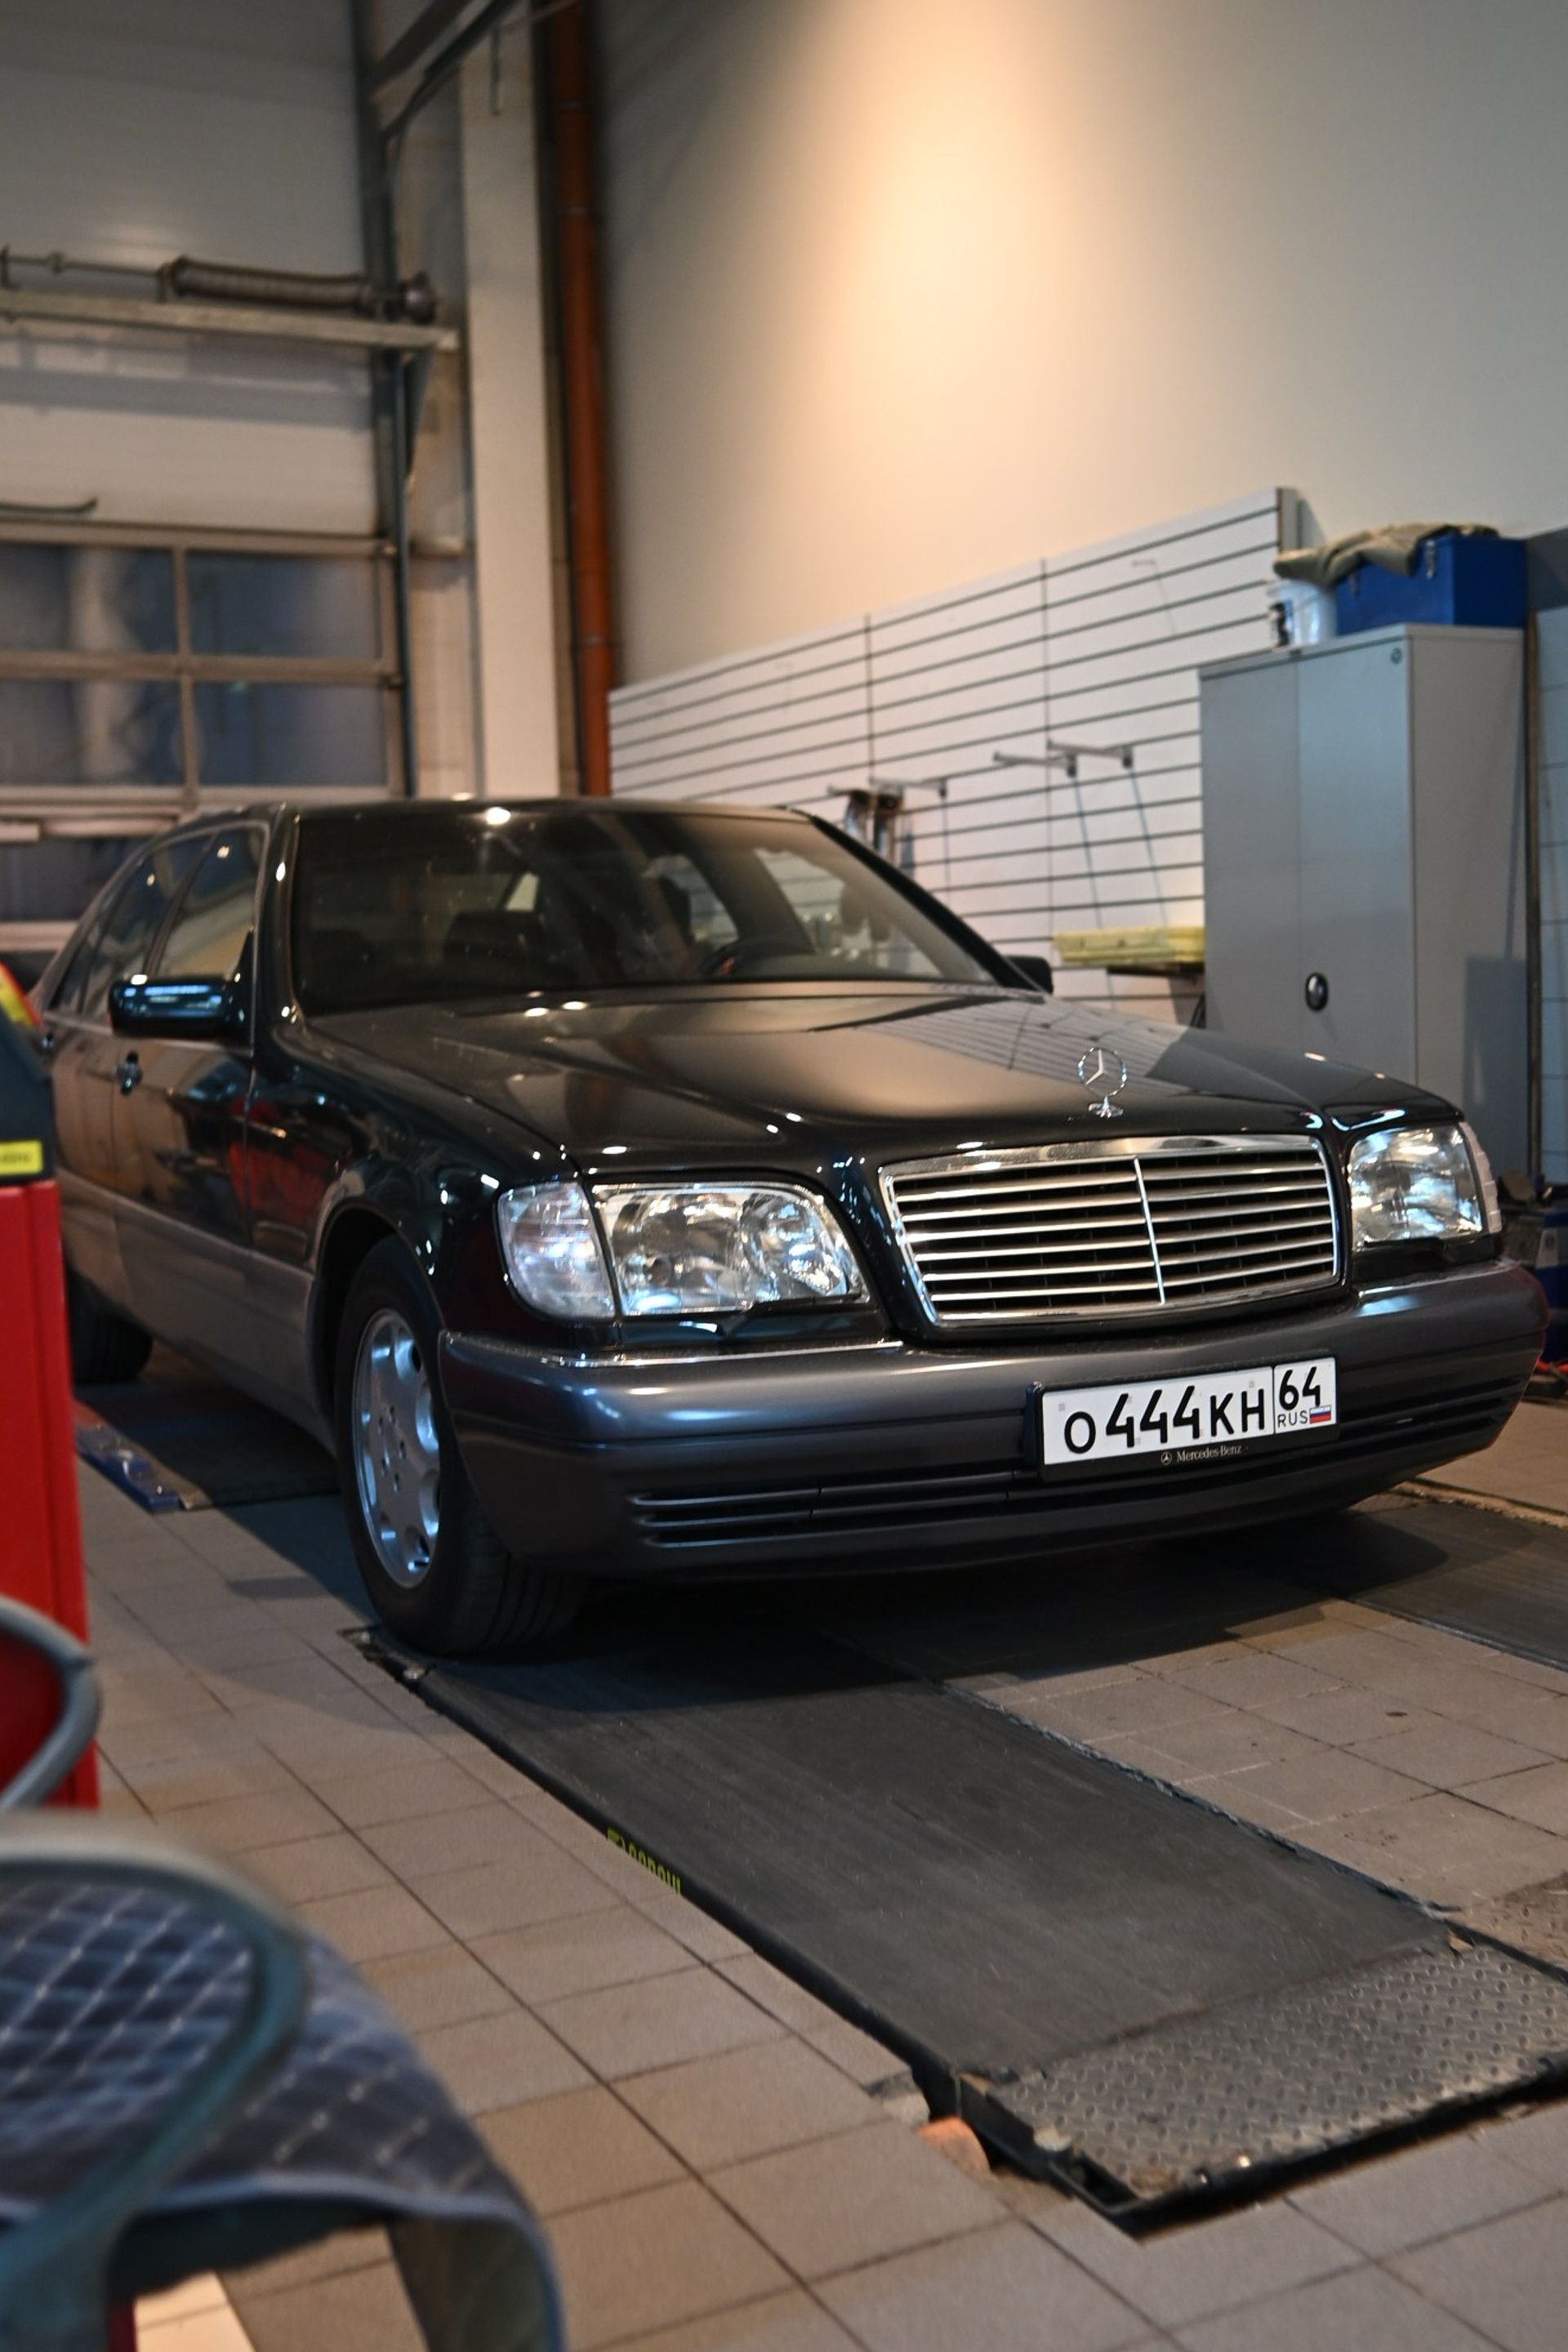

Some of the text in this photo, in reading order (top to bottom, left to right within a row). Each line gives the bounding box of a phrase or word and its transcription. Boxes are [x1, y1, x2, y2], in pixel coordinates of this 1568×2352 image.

[1278, 1366, 1321, 1411] 64
[1277, 1410, 1309, 1428] RUS
[1177, 1445, 1241, 1463] Mercedes-Benz
